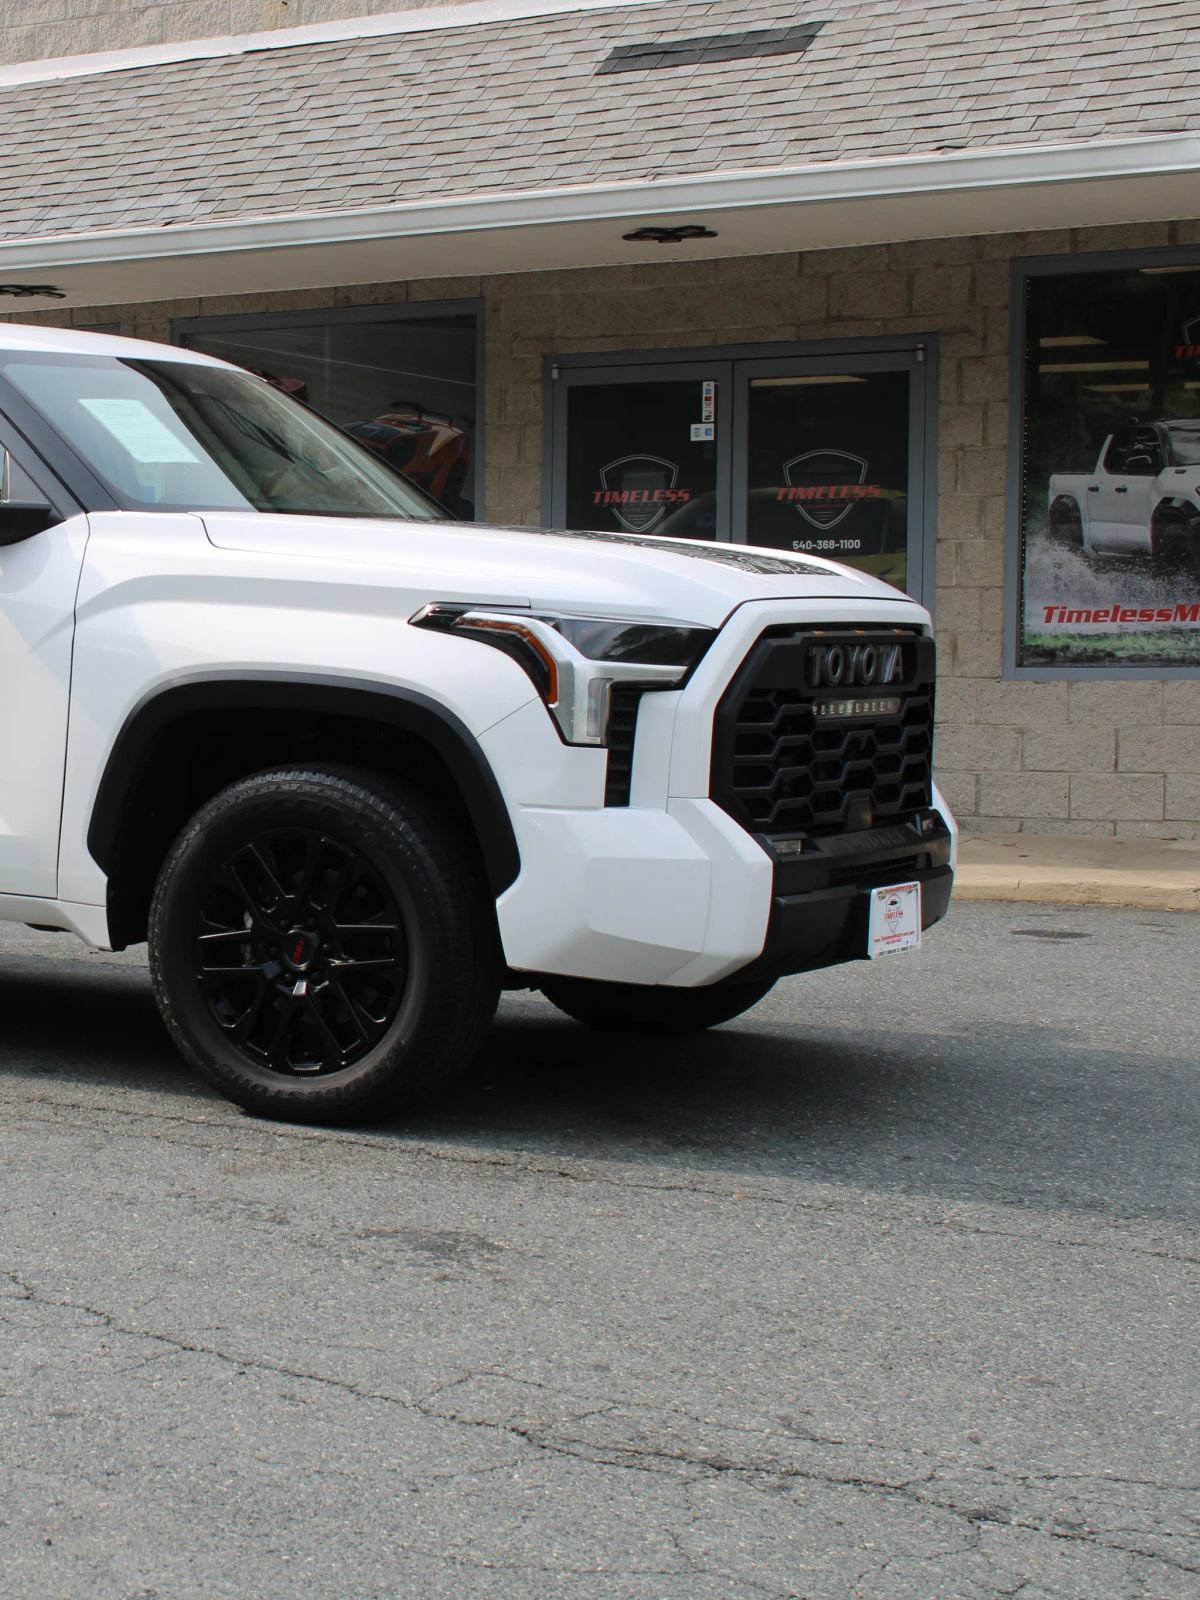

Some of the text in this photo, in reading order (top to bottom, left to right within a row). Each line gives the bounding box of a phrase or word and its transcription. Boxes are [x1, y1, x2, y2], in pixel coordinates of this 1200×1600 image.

[592, 489, 691, 504] TIMELESS
[776, 484, 880, 501] TIMELESS
[793, 540, 861, 550] 540-368-1100
[809, 643, 904, 687] TOYOTA
